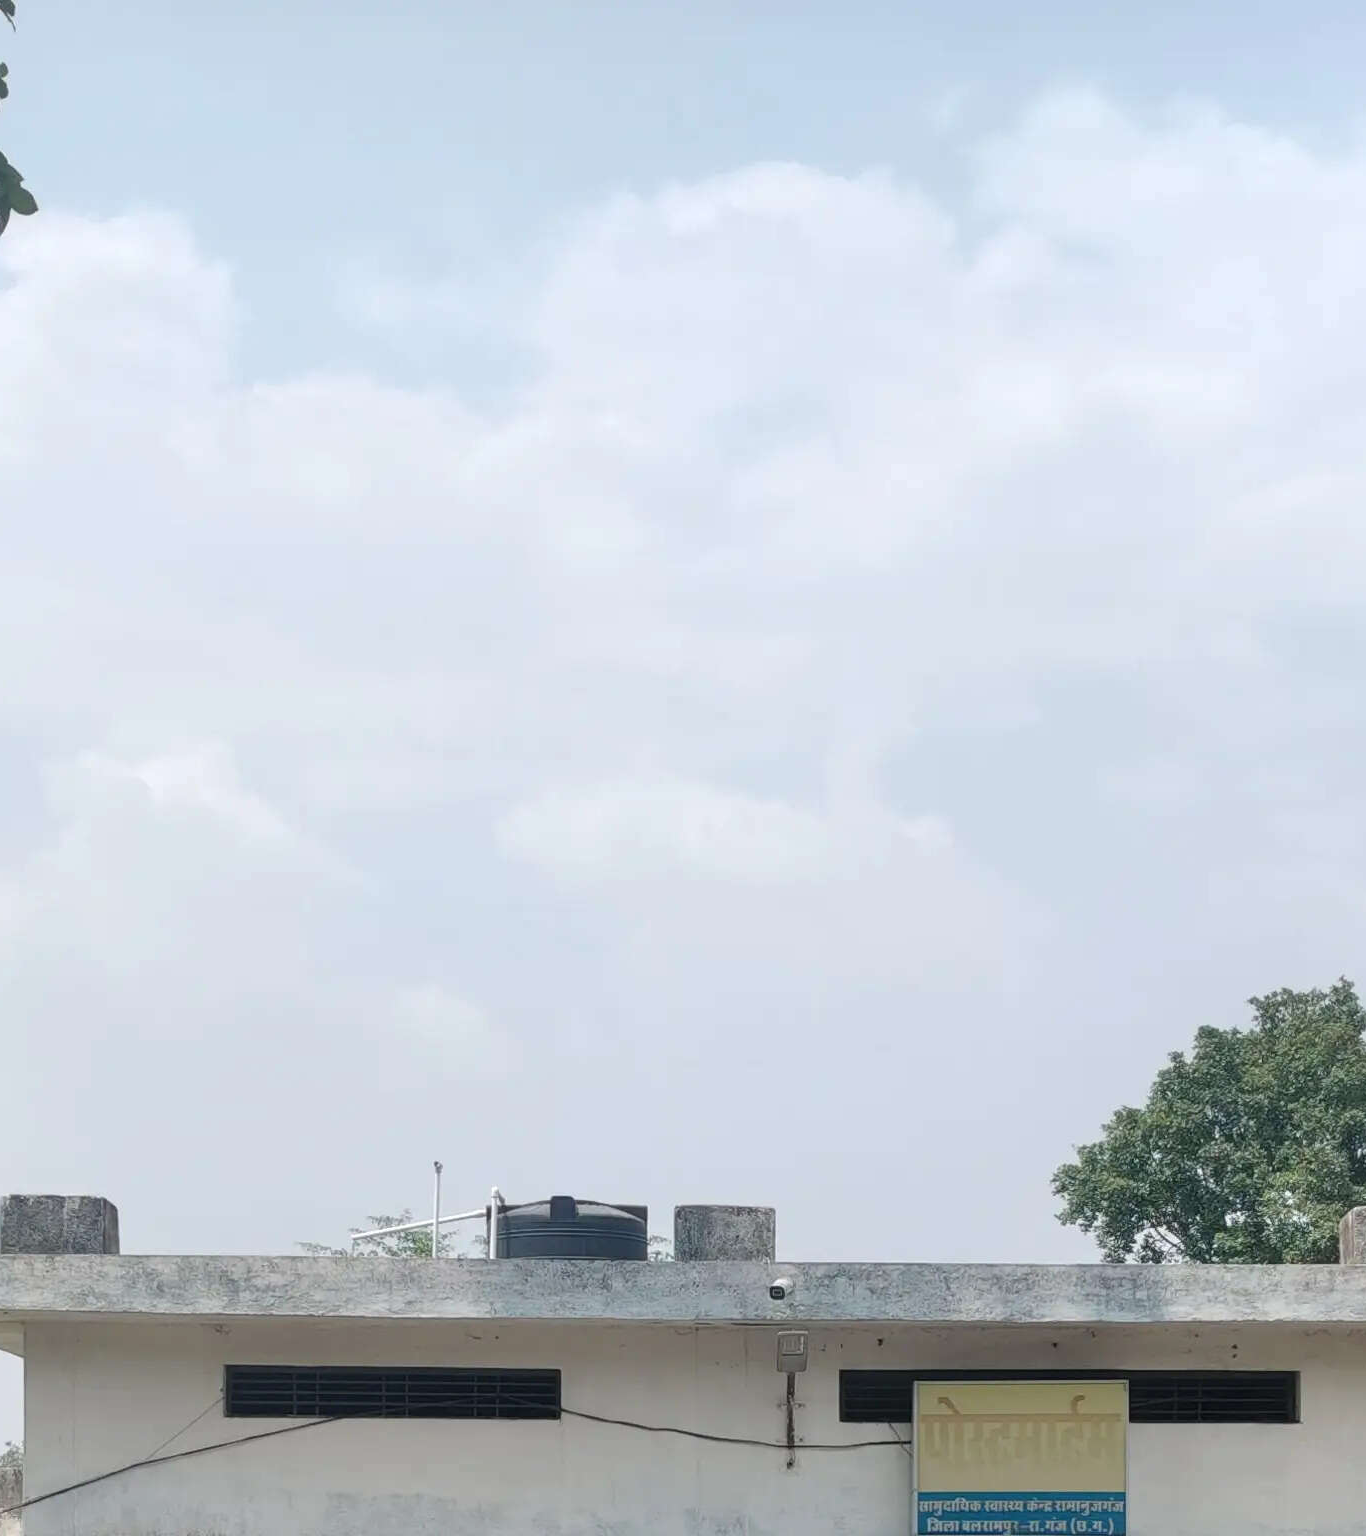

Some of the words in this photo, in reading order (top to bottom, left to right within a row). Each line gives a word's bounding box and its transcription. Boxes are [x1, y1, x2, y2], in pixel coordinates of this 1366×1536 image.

[919, 1497, 981, 1515] सामुदायिक
[984, 1499, 1023, 1513] स्वास्थ्य
[1054, 1497, 1124, 1516] रामानुजगंज
[926, 1517, 959, 1533] जिला
